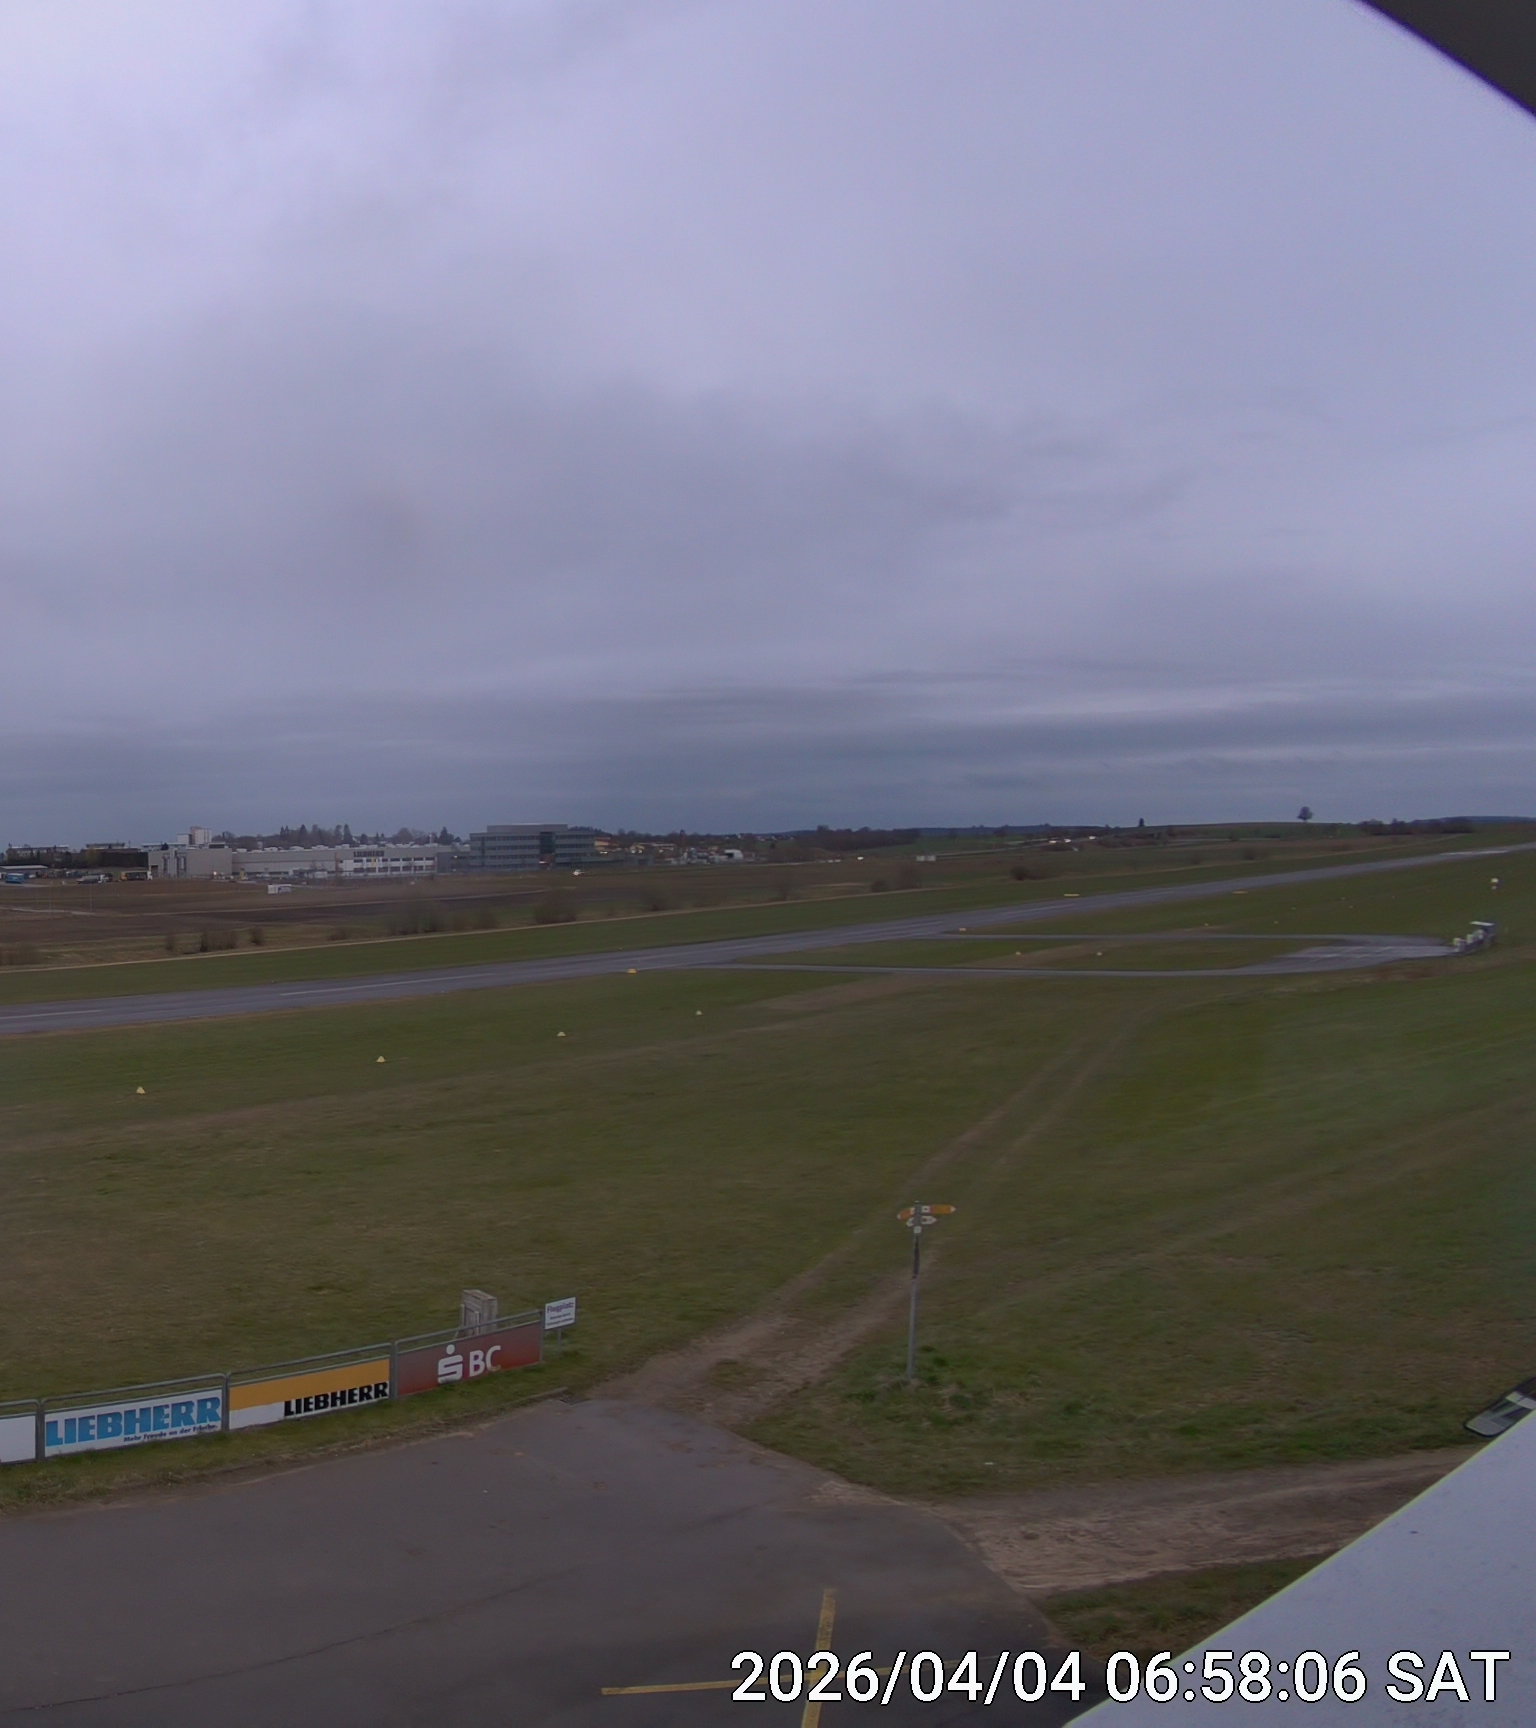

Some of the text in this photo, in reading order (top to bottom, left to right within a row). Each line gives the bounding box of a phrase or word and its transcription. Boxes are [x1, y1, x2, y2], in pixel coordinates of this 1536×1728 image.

[469, 1345, 502, 1377] BC
[284, 1381, 388, 1417] LIEBHERR
[46, 1397, 221, 1447] LIEBHERR
